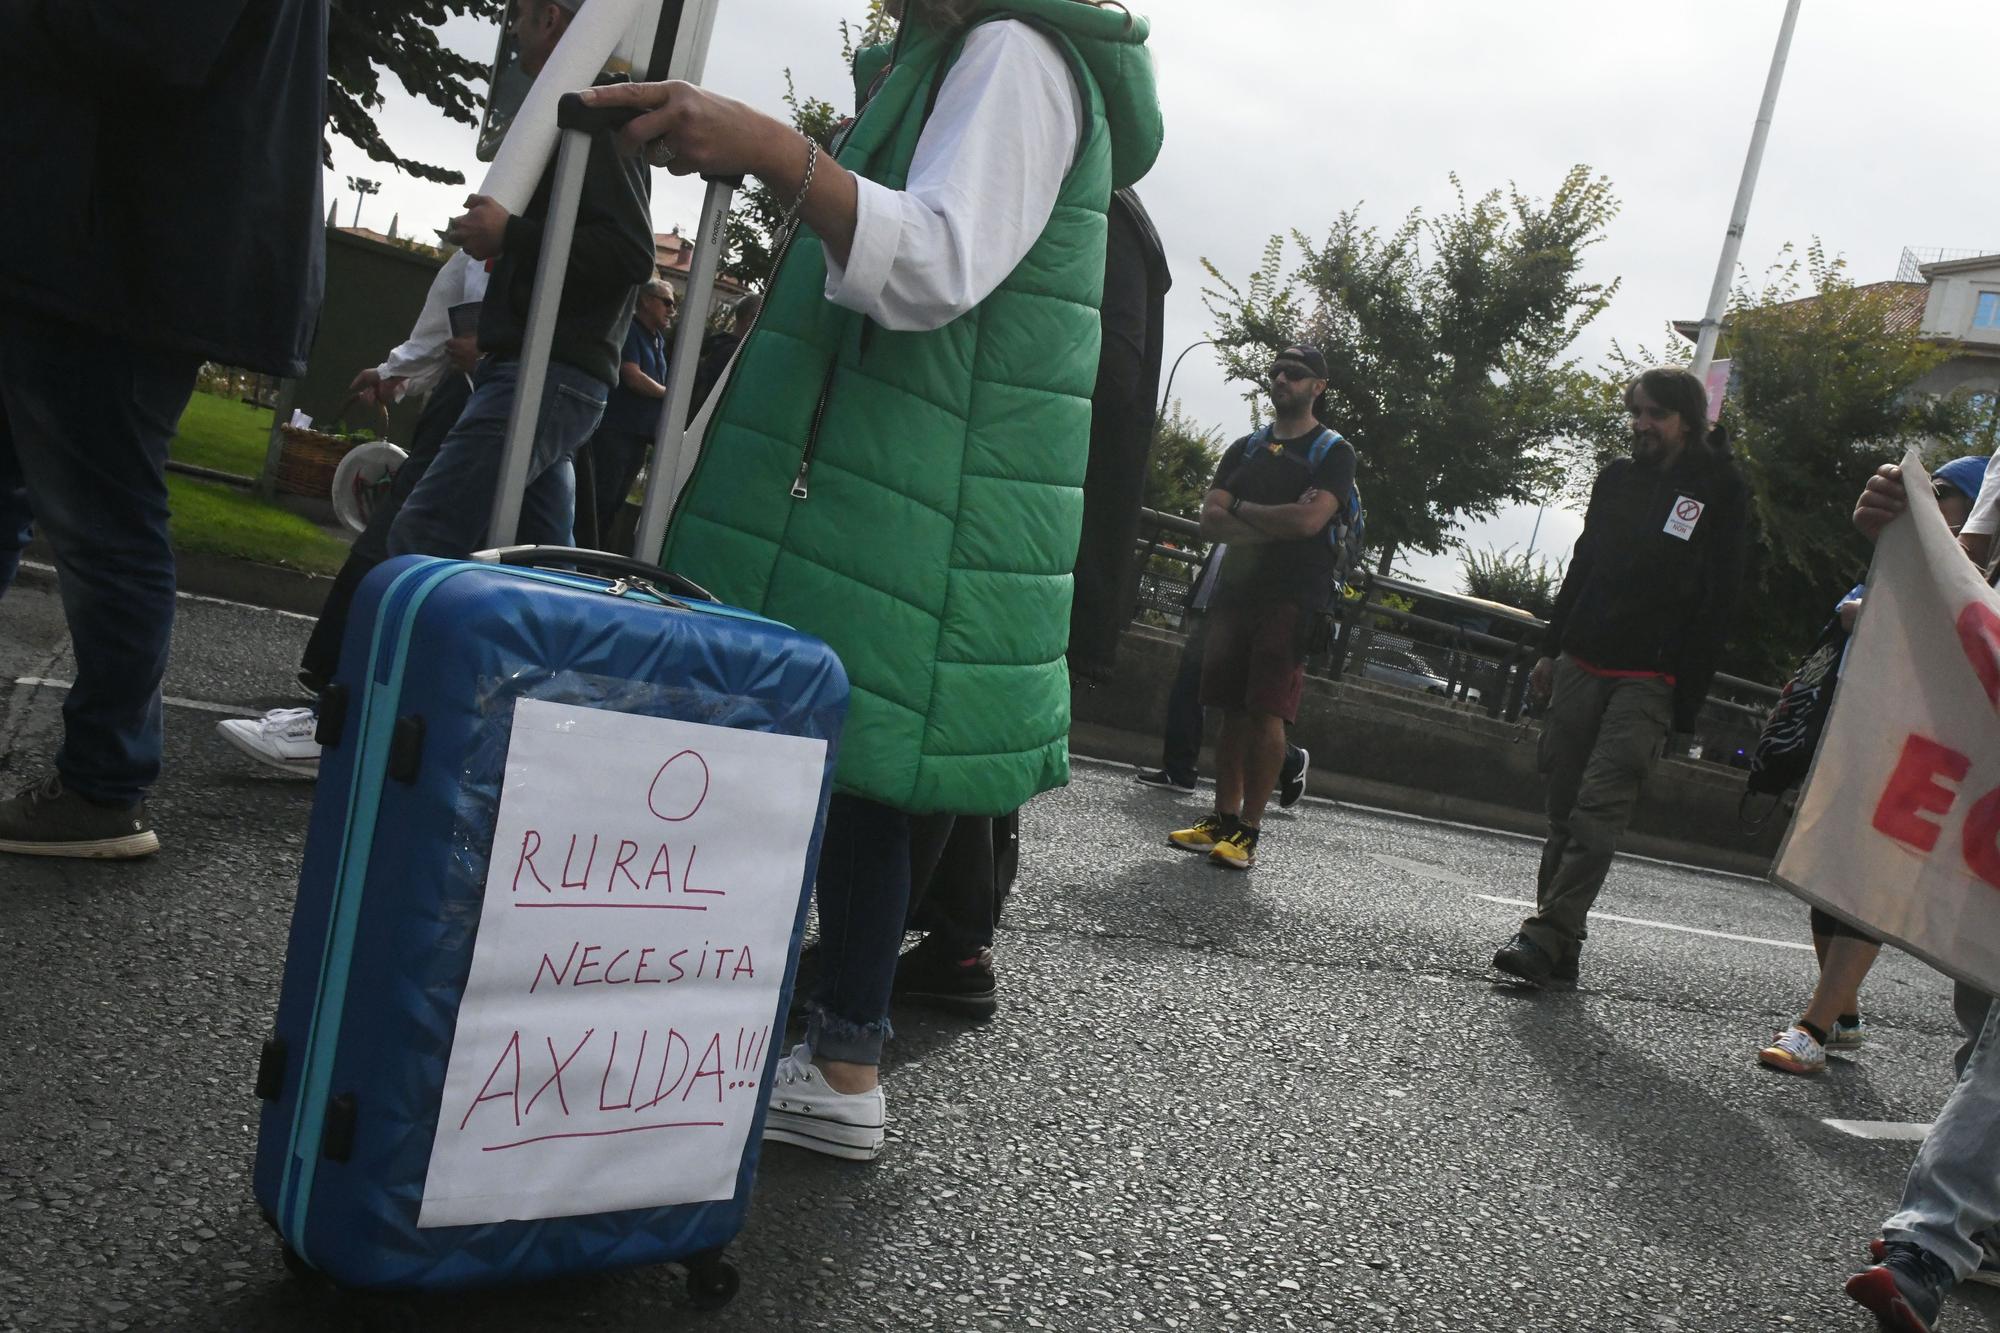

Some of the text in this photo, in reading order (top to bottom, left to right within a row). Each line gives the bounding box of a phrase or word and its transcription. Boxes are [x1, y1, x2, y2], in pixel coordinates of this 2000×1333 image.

[648, 749, 709, 821] O
[512, 830, 726, 895] RURAL
[461, 1025, 768, 1130] AXUDA!!!
